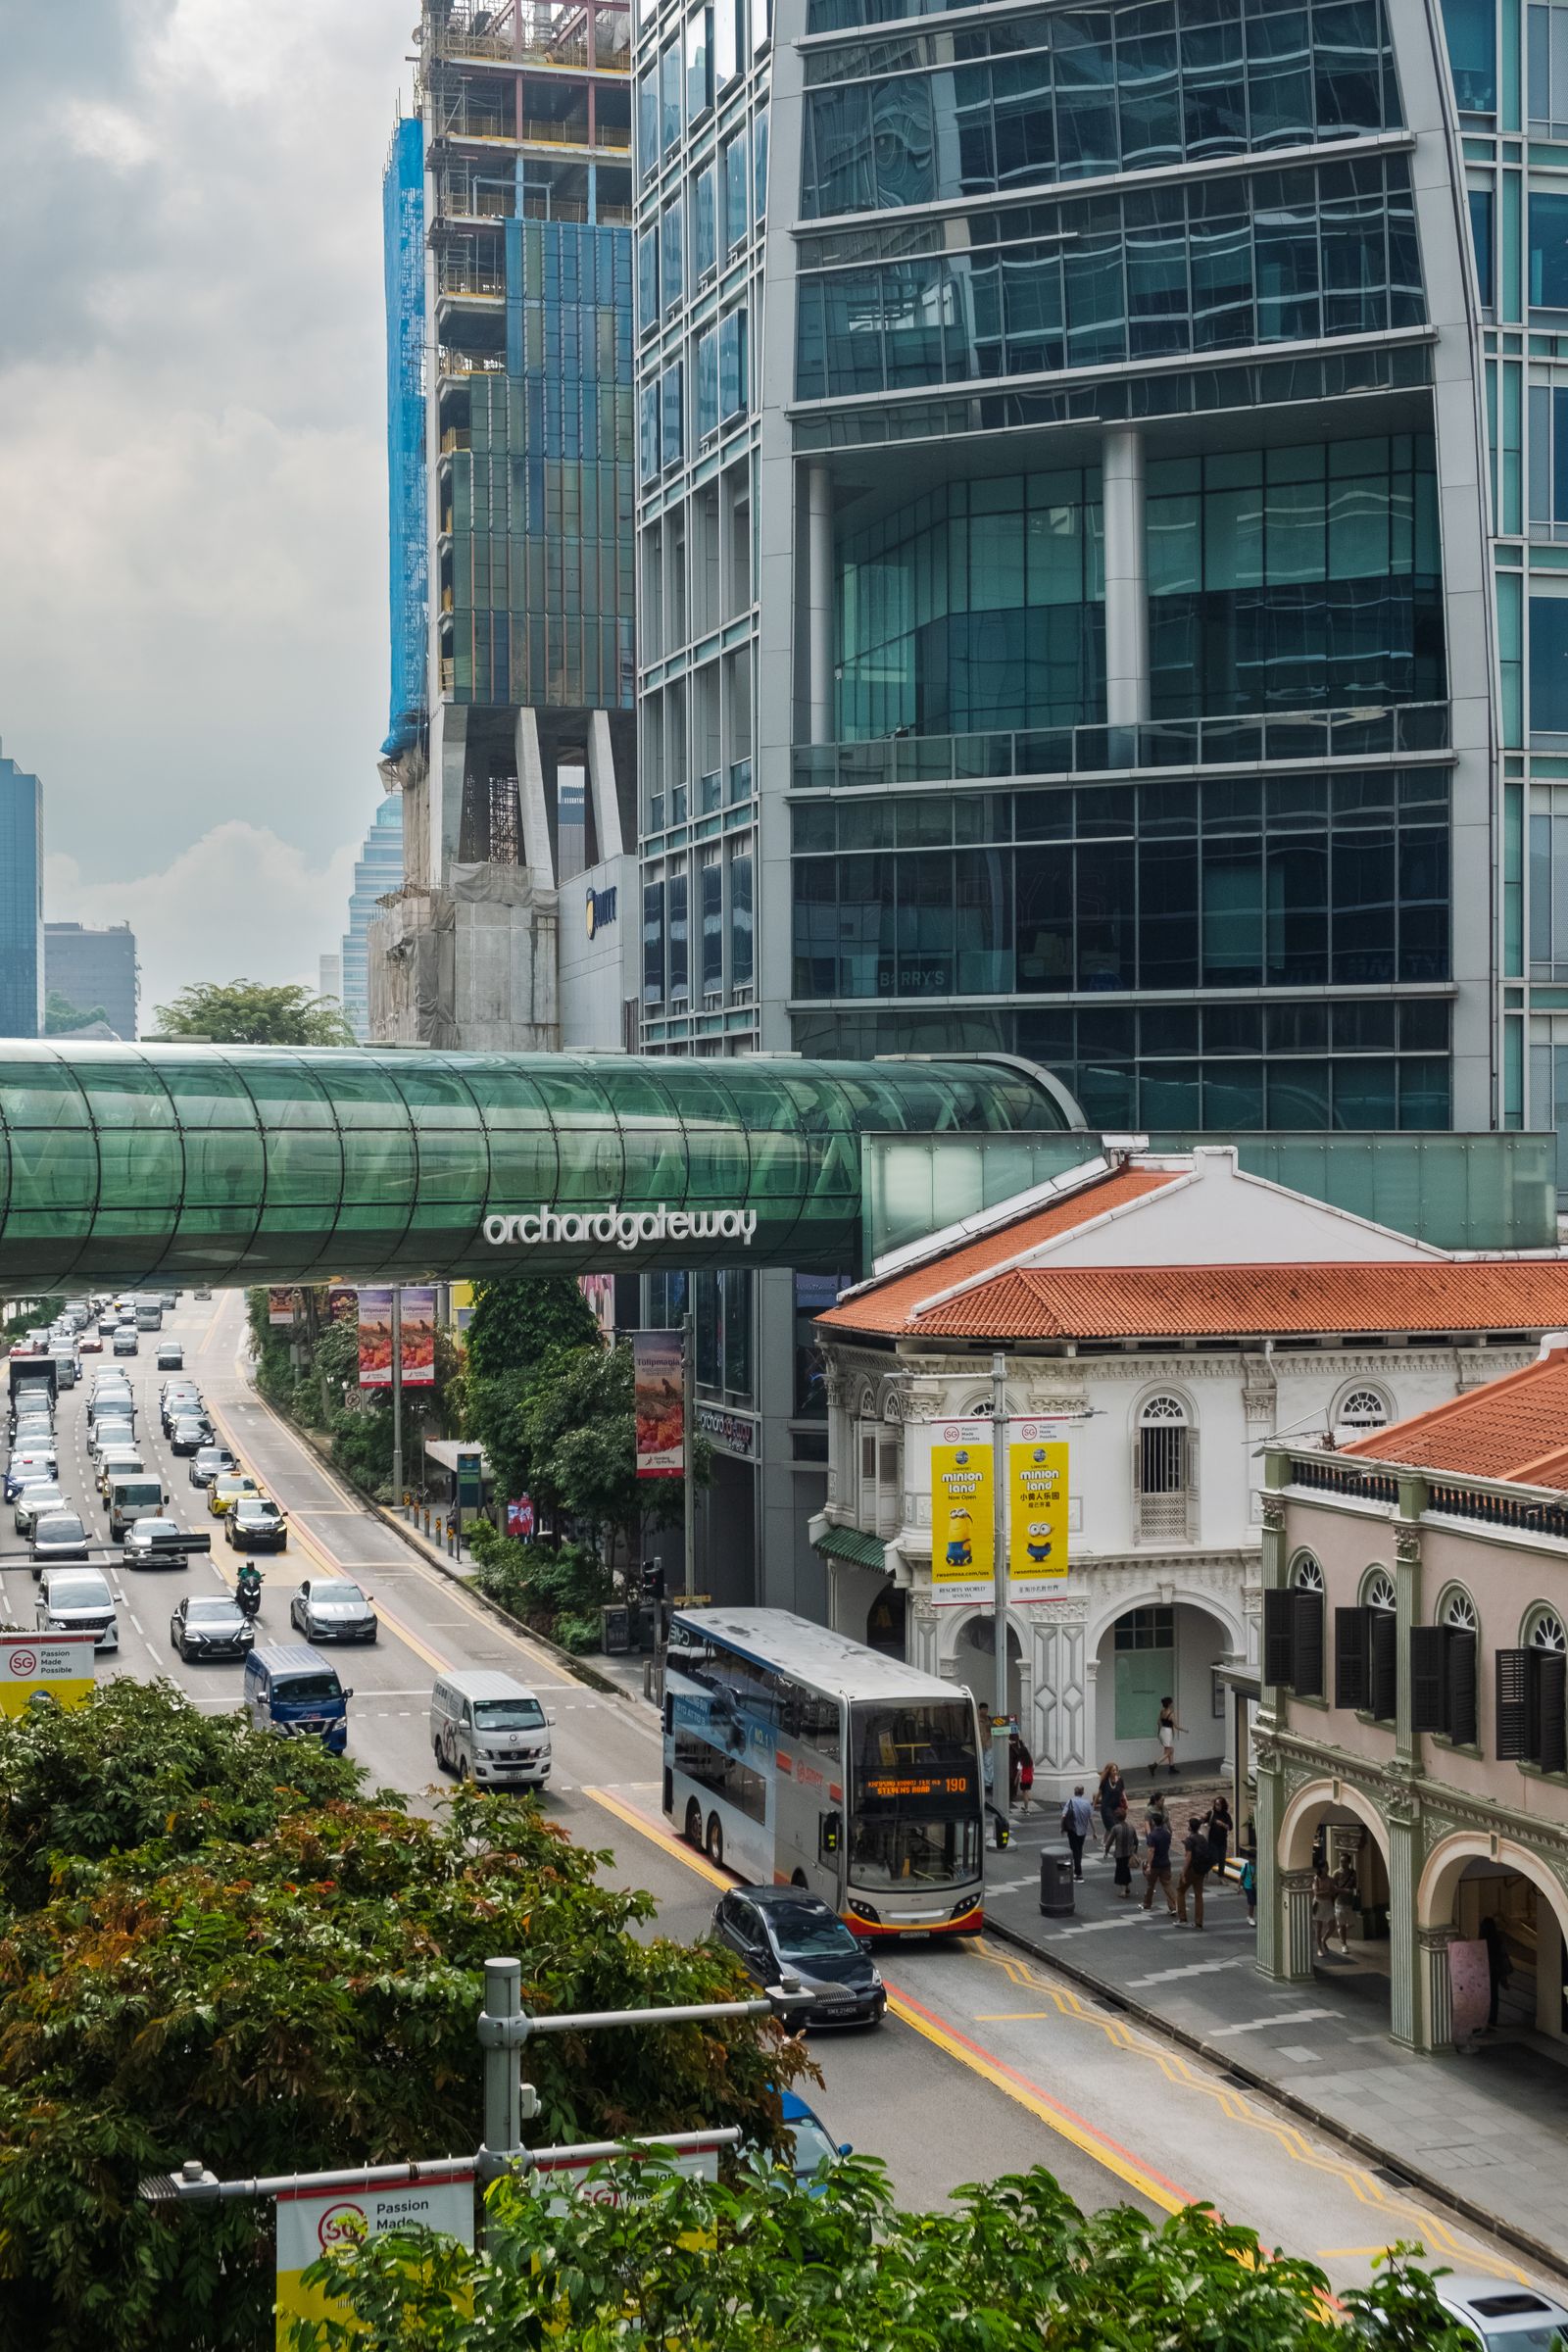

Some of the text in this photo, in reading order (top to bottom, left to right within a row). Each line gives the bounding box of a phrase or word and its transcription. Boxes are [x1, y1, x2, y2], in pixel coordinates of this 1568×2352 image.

[483, 1203, 758, 1250] orchardgateway
[947, 1430, 958, 1439] SG
[942, 1472, 983, 1482] minion
[1019, 1470, 1059, 1480] minion
[948, 1483, 976, 1494] land
[1026, 1481, 1053, 1491] land
[14, 1657, 32, 1668] SG
[946, 1778, 966, 1792] 190
[376, 2199, 429, 2215] Passion
[376, 2217, 415, 2231] Made
